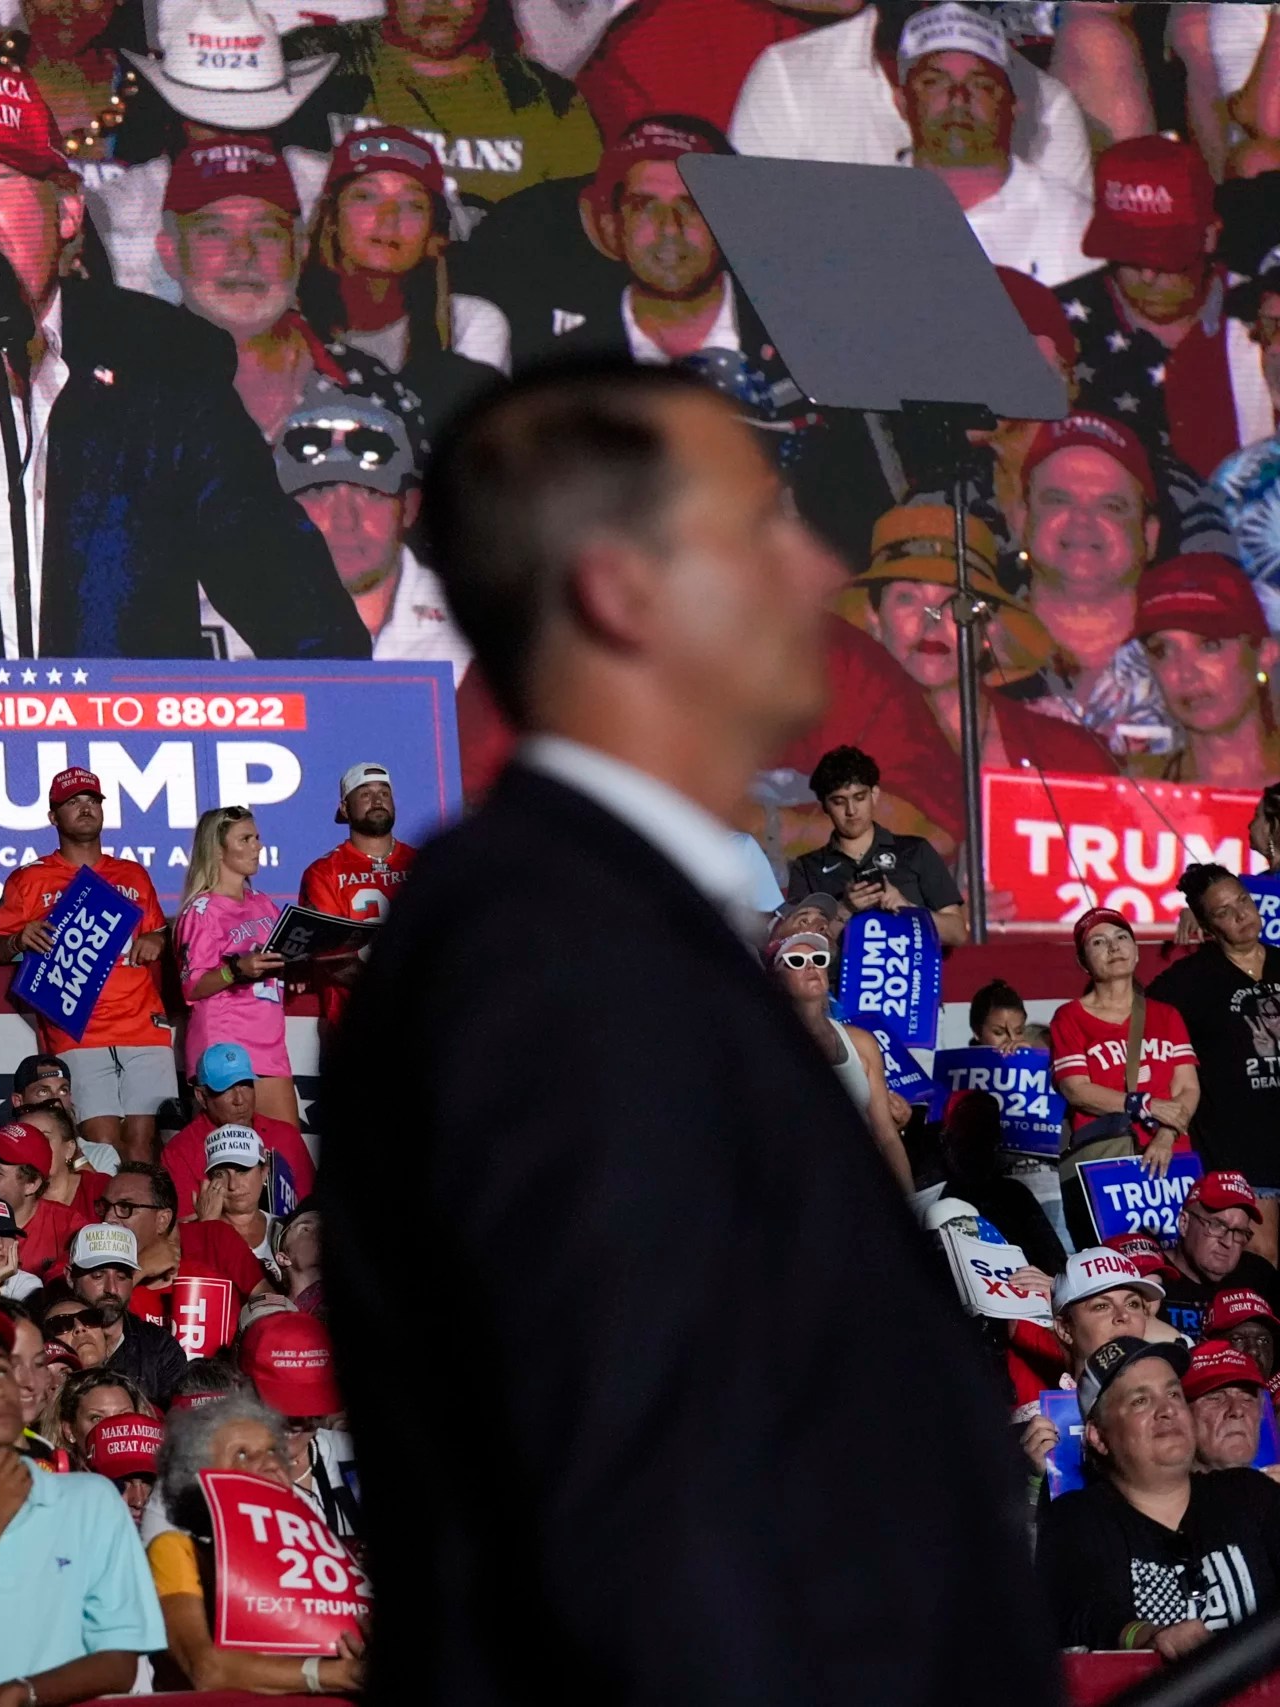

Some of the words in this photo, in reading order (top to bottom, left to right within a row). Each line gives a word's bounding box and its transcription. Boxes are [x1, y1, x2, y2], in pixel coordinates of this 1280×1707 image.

[188, 33, 266, 50] TRUMP
[197, 51, 259, 69] 2024
[87, 696, 144, 727] TO
[156, 696, 285, 727] 88022
[56, 771, 72, 783] MAKE
[107, 846, 156, 867] EAT
[338, 872, 377, 889] PAPI
[74, 885, 92, 911] TEXT
[912, 916, 923, 949] 88022
[46, 906, 96, 989] 2024
[61, 909, 123, 1017] TRUMP
[858, 917, 888, 1012] RUMP
[912, 951, 924, 967] TO
[29, 961, 47, 993] 88022
[882, 934, 911, 1018] 2024
[910, 969, 922, 1006] TRUMP
[907, 1008, 919, 1036] TEXT
[1086, 1037, 1176, 1071] TRMP
[1246, 1057, 1260, 1076] 2
[947, 1067, 1057, 1095] TRUM
[206, 1133, 221, 1145] MAKE
[221, 1130, 255, 1140] AMERICA
[1014, 1120, 1030, 1131] TO
[1032, 1122, 1063, 1135] 8802
[208, 1143, 227, 1155] GREAT
[227, 1141, 251, 1151] AGAIN
[1125, 1206, 1182, 1235] 202
[85, 1230, 105, 1242] MAKE
[105, 1231, 133, 1246] AMERICA
[88, 1240, 112, 1252] GREAT
[112, 1241, 132, 1254] AGAIN
[1080, 1255, 1137, 1279] TRUMP
[1222, 1292, 1245, 1304] MAKE
[1229, 1302, 1252, 1314] GREAT
[1166, 1306, 1204, 1329] TR
[271, 1350, 297, 1358] MAKE
[273, 1360, 304, 1368] GREAT
[1192, 1354, 1212, 1362] AKE
[101, 1424, 130, 1440] MAKE
[130, 1423, 163, 1441] AMERIC
[107, 1440, 139, 1455] GREAT
[140, 1441, 161, 1455] AGA
[237, 1502, 347, 1560] TRU
[276, 1547, 375, 1599] 202
[245, 1596, 296, 1614] TEXT
[301, 1598, 370, 1616] TRUMP
